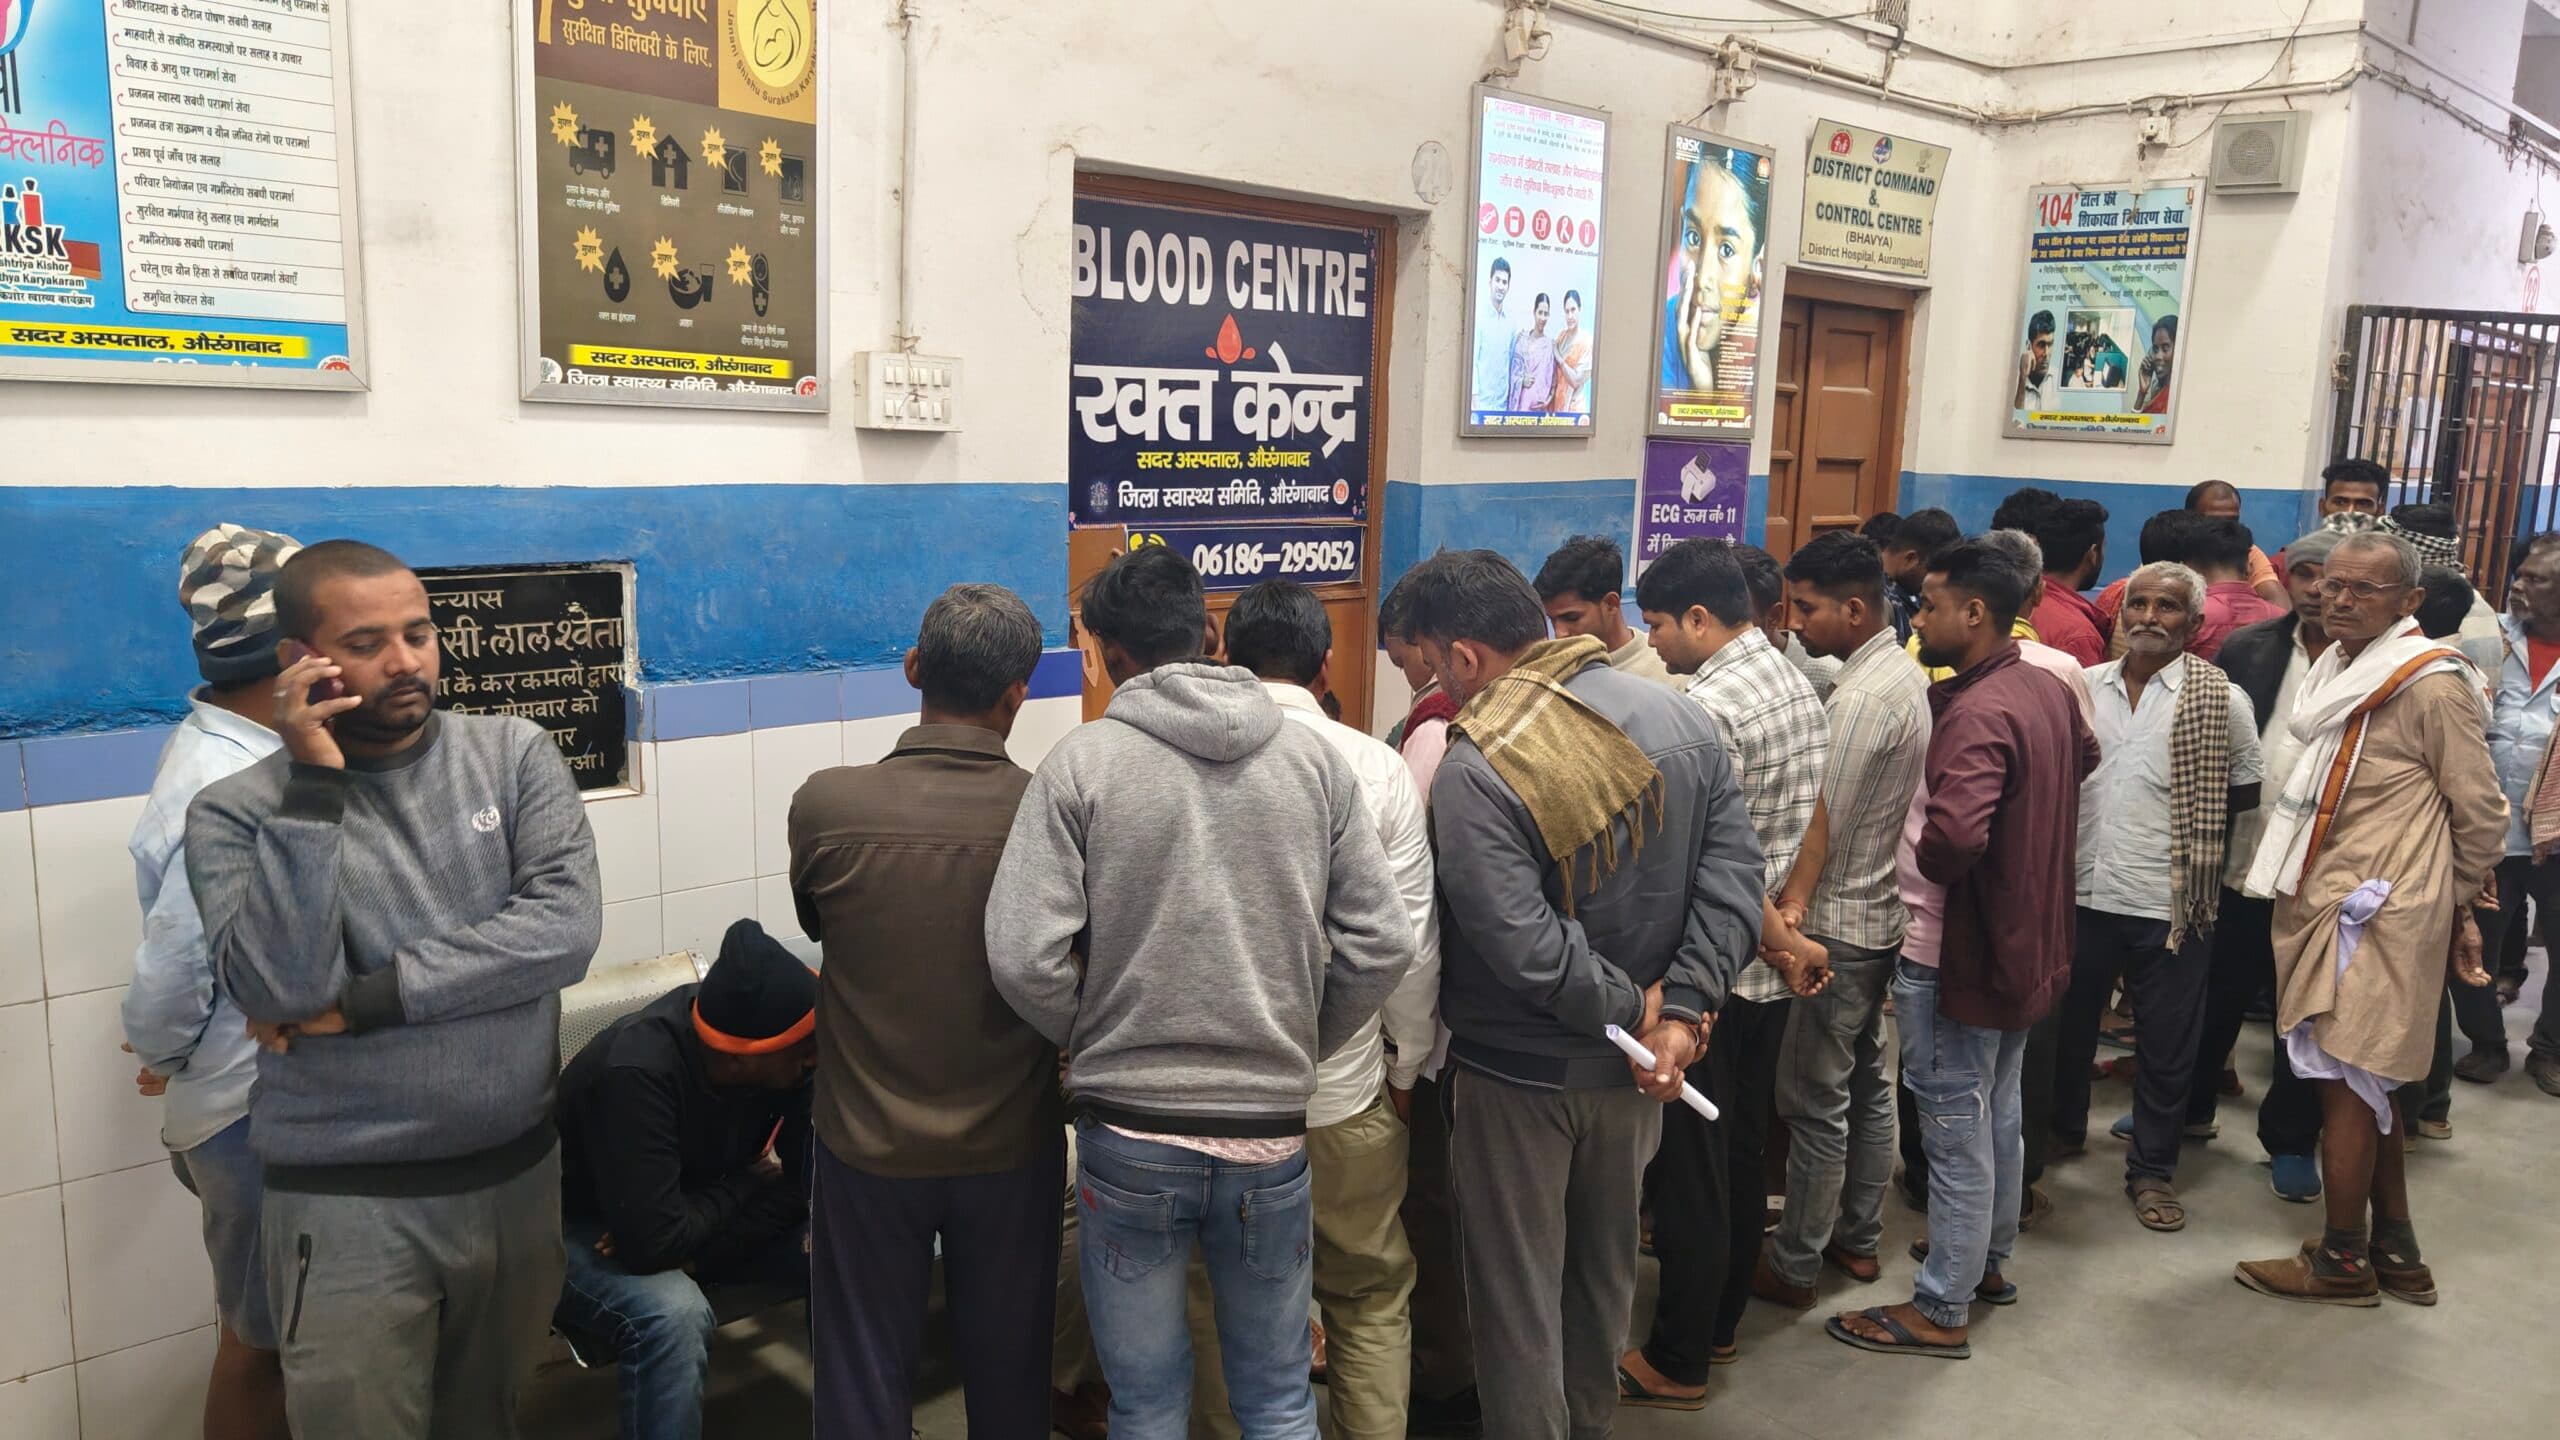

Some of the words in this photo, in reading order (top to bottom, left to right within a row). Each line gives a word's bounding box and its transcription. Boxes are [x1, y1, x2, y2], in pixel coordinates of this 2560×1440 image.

[236, 45, 247, 56] पर
[562, 17, 606, 46] सुरक्षित
[611, 23, 661, 57] डिलिवरी
[665, 34, 679, 60] के
[125, 54, 148, 72] विवाह
[161, 62, 178, 79] आयु
[180, 65, 190, 76] पर
[193, 67, 220, 81] परामर्श
[221, 69, 236, 83] सेवा
[736, 59, 761, 96] Shishu
[762, 90, 800, 105] Suraksha
[128, 87, 154, 101] प्रजनन
[207, 97, 234, 111] परामर्श
[235, 101, 250, 114] सेवा
[130, 117, 156, 130] प्रजनन
[215, 125, 230, 139] यौन
[231, 127, 253, 141] जनित
[273, 135, 283, 146] पर
[285, 135, 310, 149] परामर्श
[132, 146, 151, 158] प्रसव
[153, 146, 165, 164] पूर्व
[200, 155, 221, 167] सलाह
[134, 173, 160, 188] परिवार
[162, 175, 194, 191] नियोजन
[269, 188, 295, 202] परामर्श
[1812, 156, 1872, 184] DISTRICT
[1874, 166, 1935, 197] COMMAND
[136, 203, 165, 220] सुरक्षित
[167, 206, 194, 220] गर्भपात
[196, 207, 209, 226] हेतु
[210, 212, 232, 225] सलाह
[247, 213, 279, 228] मार्गदर्शन
[1816, 203, 1874, 227] CONTROL
[1877, 214, 1922, 235] CENTRE
[2078, 211, 2119, 227] शिकायत
[2163, 207, 2184, 224] सेवा
[0, 223, 66, 257] KSK
[138, 231, 182, 247] गर्भनिरोधक
[207, 237, 234, 252] परामर्श
[1845, 231, 1893, 248] (BHAVYA)
[0, 258, 34, 271] shtriya
[36, 260, 69, 272] Kishor
[1808, 243, 1839, 258] District
[1841, 248, 1876, 263] Hospital,
[1878, 253, 1923, 269] Aurangabad
[0, 272, 20, 284] thya
[23, 273, 85, 287] Karyakaram
[140, 260, 160, 278] घरेलू
[175, 262, 191, 277] यौन
[212, 265, 220, 279] से
[250, 268, 276, 283] परामर्श
[1072, 224, 1213, 306] BLOOD
[1225, 240, 1367, 317] CENTRE
[143, 289, 171, 307] समुचित
[173, 290, 197, 305] रेफरल
[200, 292, 215, 306] सेवा
[11, 328, 65, 344] सदर
[71, 331, 175, 350] अस्पताल,
[183, 332, 282, 354] औरंगाबाद
[591, 351, 628, 365] सदर
[630, 354, 699, 371] अस्पताल,
[705, 355, 772, 375] औरंगाबाद
[1073, 363, 1219, 443] रक्त
[1230, 340, 1363, 458] केन्द्र
[1136, 450, 1173, 470] सदर
[1175, 450, 1244, 471] अस्पताल,
[1247, 445, 1311, 468] औरंगाबाद
[1118, 479, 1158, 509] जिला
[1162, 486, 1213, 508] स्वास्थ्य
[1217, 478, 1265, 507] समिति,
[1269, 477, 1330, 504] औरंगाबाद
[1651, 503, 1680, 523] ECG
[1683, 508, 1707, 524] रूम
[1727, 506, 1736, 523] 11
[1647, 532, 1660, 553] में
[428, 590, 504, 611] न्यास
[454, 667, 477, 695] के
[570, 689, 599, 715] को
